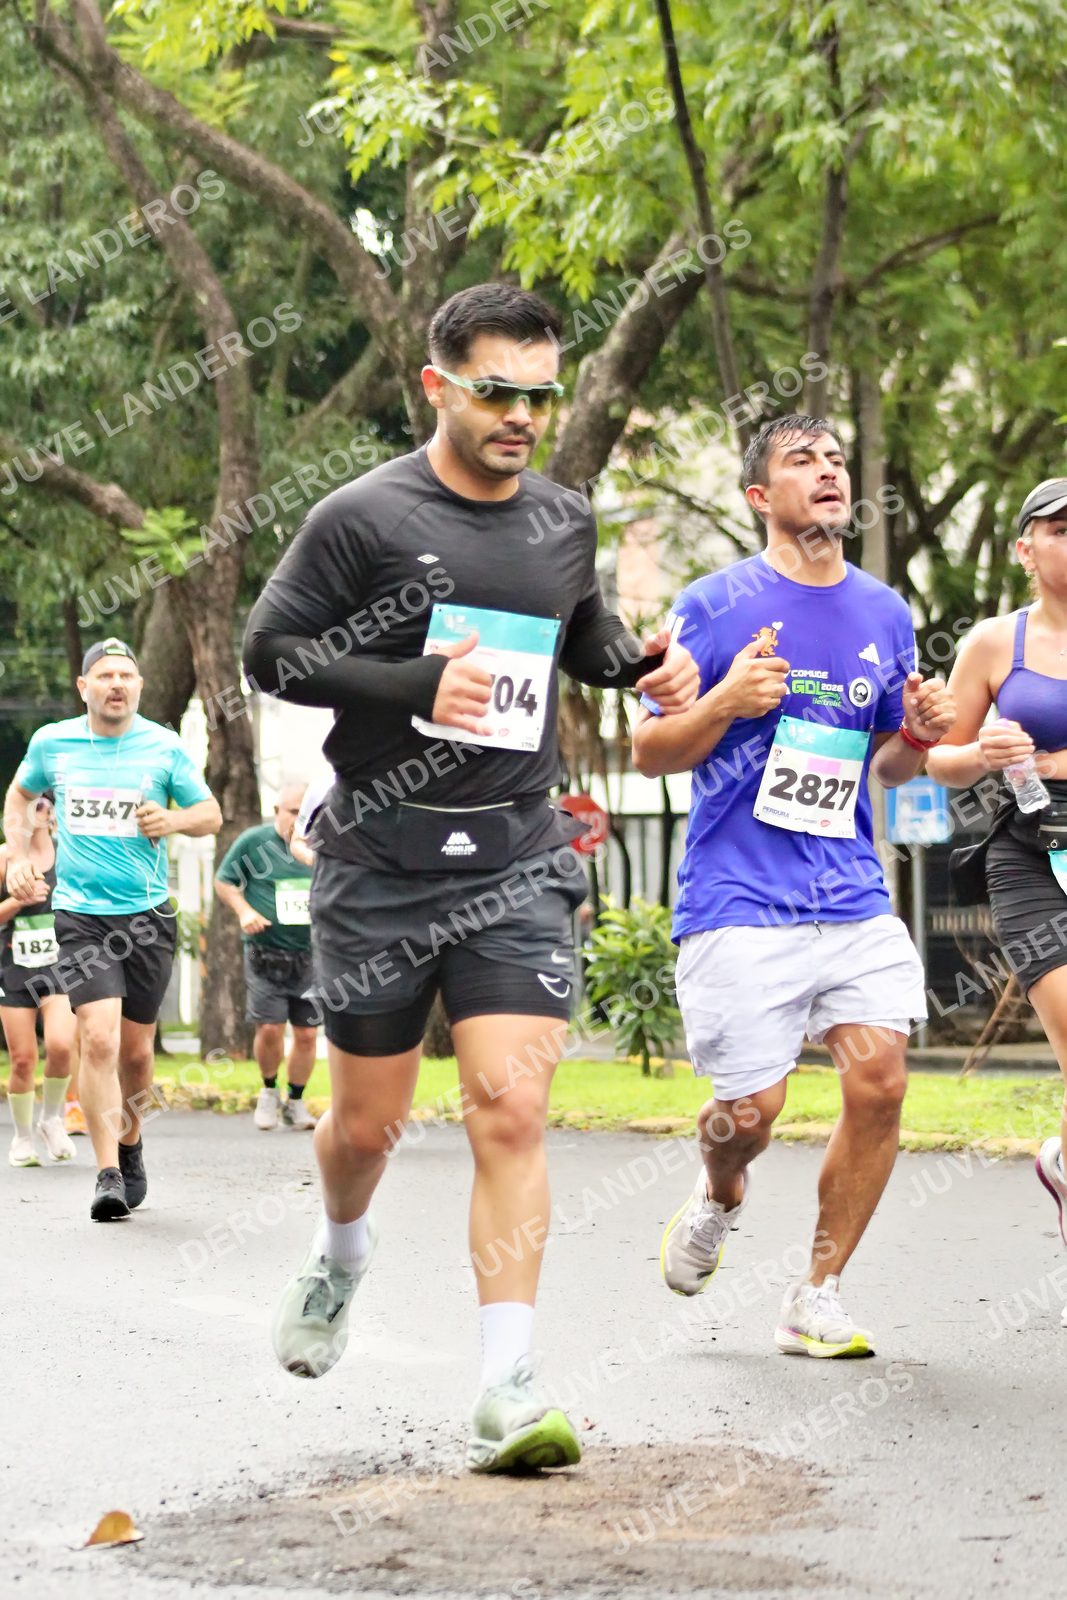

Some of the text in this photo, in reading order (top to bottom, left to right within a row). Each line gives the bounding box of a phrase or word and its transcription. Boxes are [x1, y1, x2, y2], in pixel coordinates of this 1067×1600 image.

[790, 669, 829, 680] COMUDE
[791, 679, 823, 696] GDL
[768, 767, 856, 811] 2827
[70, 799, 135, 820] 3347
